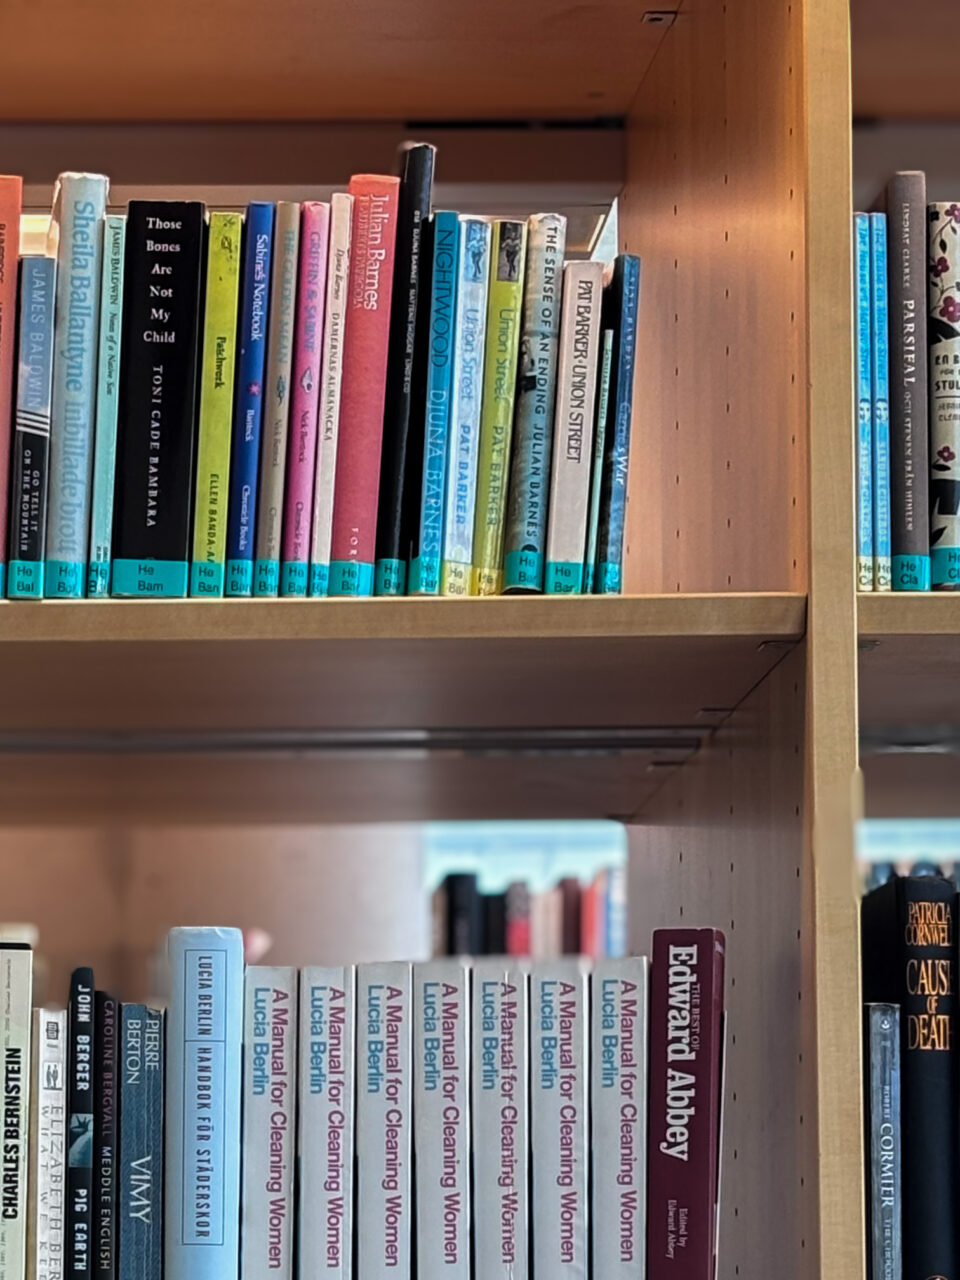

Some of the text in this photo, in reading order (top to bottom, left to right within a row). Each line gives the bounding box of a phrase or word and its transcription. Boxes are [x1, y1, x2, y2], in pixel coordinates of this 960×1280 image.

[146, 240, 181, 252] Bones
[147, 217, 182, 229] Those
[365, 195, 388, 309] Julian Barnes
[57, 201, 95, 391] Sheila Ballantyne
[150, 286, 173, 297] Not
[151, 264, 172, 274] Are
[251, 283, 264, 341] Notebook
[27, 269, 45, 408] JAMES BALDWIN
[143, 331, 175, 343] Child
[151, 308, 170, 321] My
[902, 300, 915, 387] PARSIFAL
[422, 229, 453, 552] NIGHTWOOD DJUNA BARNES
[525, 226, 557, 537] THE SENSE OF AN ENDING JULIAN BARNES
[567, 280, 593, 462] PAT BARKER UNION STREET
[147, 365, 162, 527] TONI CADE BAMBARA
[138, 565, 155, 574] He
[138, 581, 163, 591] Bam
[126, 1020, 141, 1084] BERTON
[145, 1020, 160, 1070] PIERRE
[253, 988, 269, 1095] Lucia Berlin
[661, 945, 697, 1161] Edward Abbey
[5, 1048, 22, 1140] BERNSTEIN
[74, 985, 90, 1270] JOHN BERGER PIG EARTH
[100, 1000, 114, 1269] CAROLINE BERGVALL MEDDLE ENGLISH
[196, 956, 212, 1237] LUCIA BERLIN HANDBOK FÖR STÄDERSKOR
[267, 988, 288, 1268] A Manual for Cleaning Women
[2, 1144, 19, 1219] CHARLES
[129, 1156, 151, 1223] VIMY
[879, 1123, 895, 1208] CORMIER
